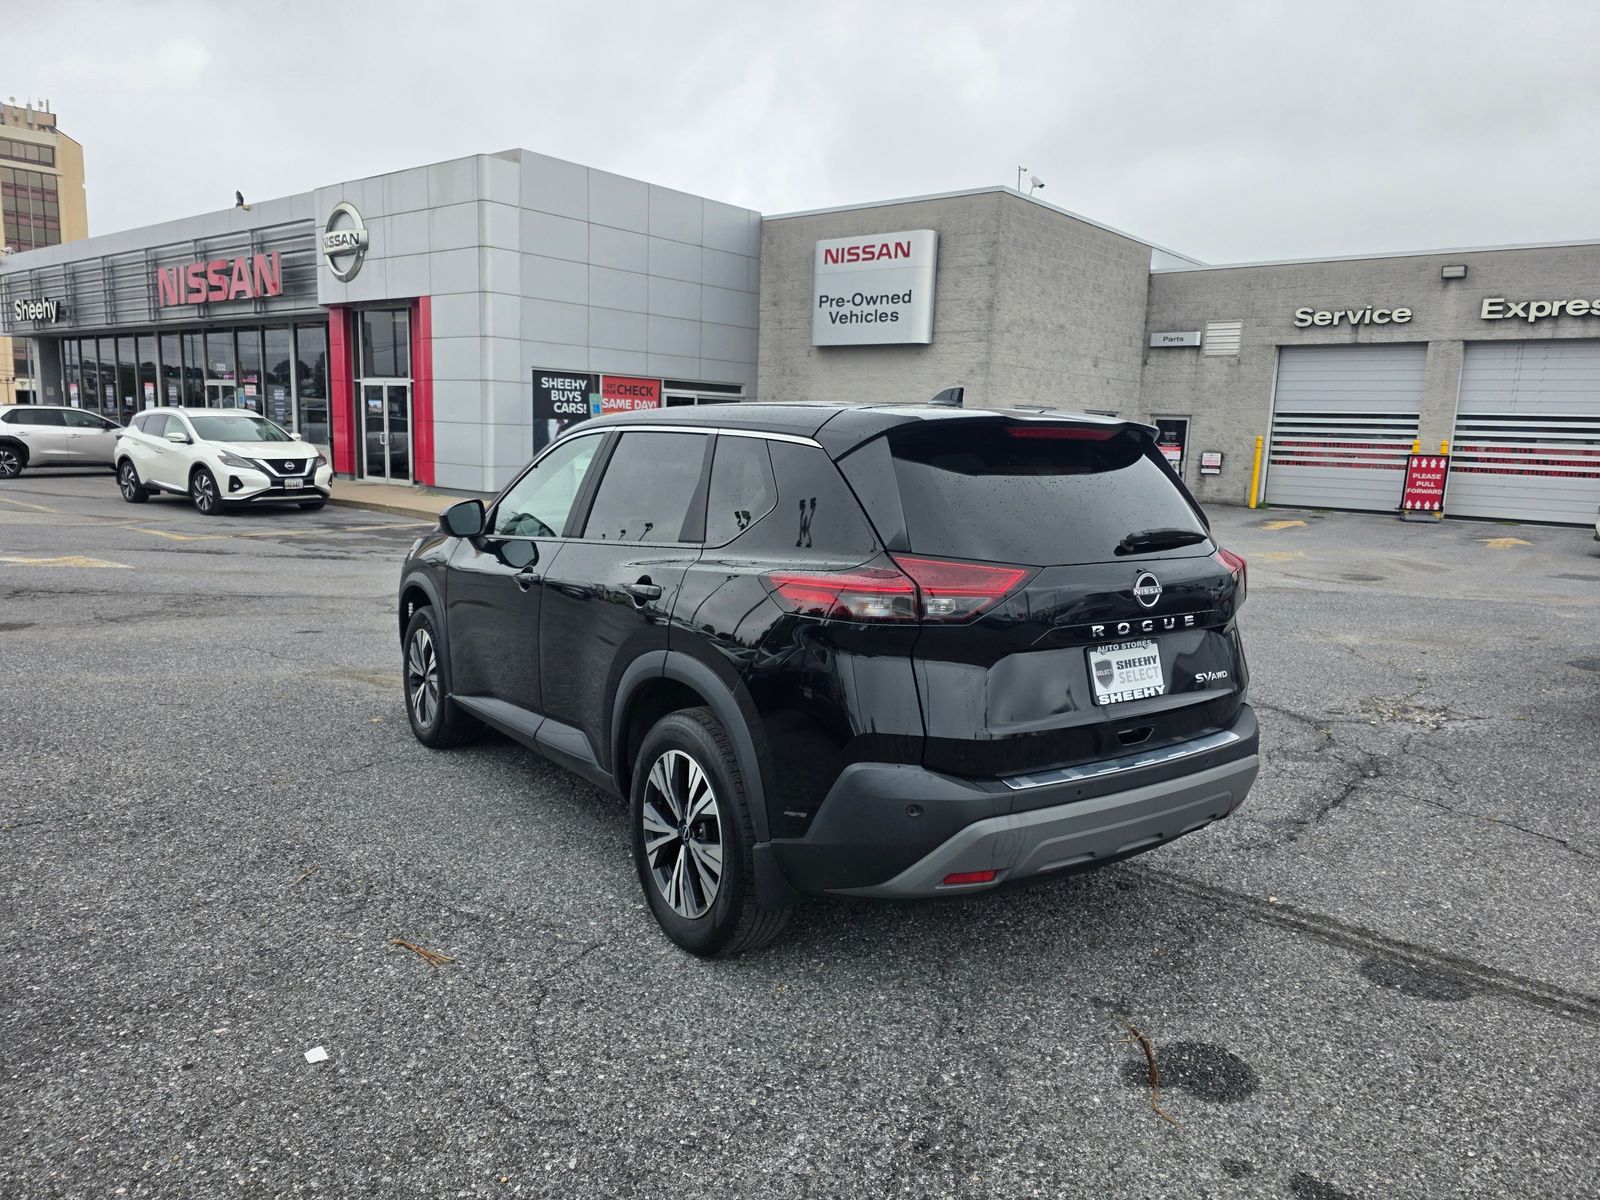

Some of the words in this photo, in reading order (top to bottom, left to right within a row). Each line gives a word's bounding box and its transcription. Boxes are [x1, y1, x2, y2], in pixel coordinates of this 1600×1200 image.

[824, 241, 911, 265] NISSAN
[157, 251, 283, 308] NISSAN
[819, 290, 912, 308] Pre-Owned
[14, 297, 59, 324] Sheehy
[829, 309, 899, 324] Vehicles
[1293, 305, 1412, 327] Service
[541, 377, 587, 390] SHEEHY
[616, 384, 653, 396] CHECK
[551, 390, 582, 402] BUYS
[553, 402, 587, 414] CARS!
[602, 398, 632, 409] SAME
[634, 399, 656, 410] DAY!
[1133, 587, 1162, 595] NISSAN
[1091, 615, 1195, 637] ROGUE
[1097, 644, 1119, 654] AUTO
[1121, 640, 1152, 650] STORES
[1116, 655, 1157, 670] SHEEHY
[1119, 666, 1159, 684] SELECT
[1099, 685, 1165, 705] SHEEHY
